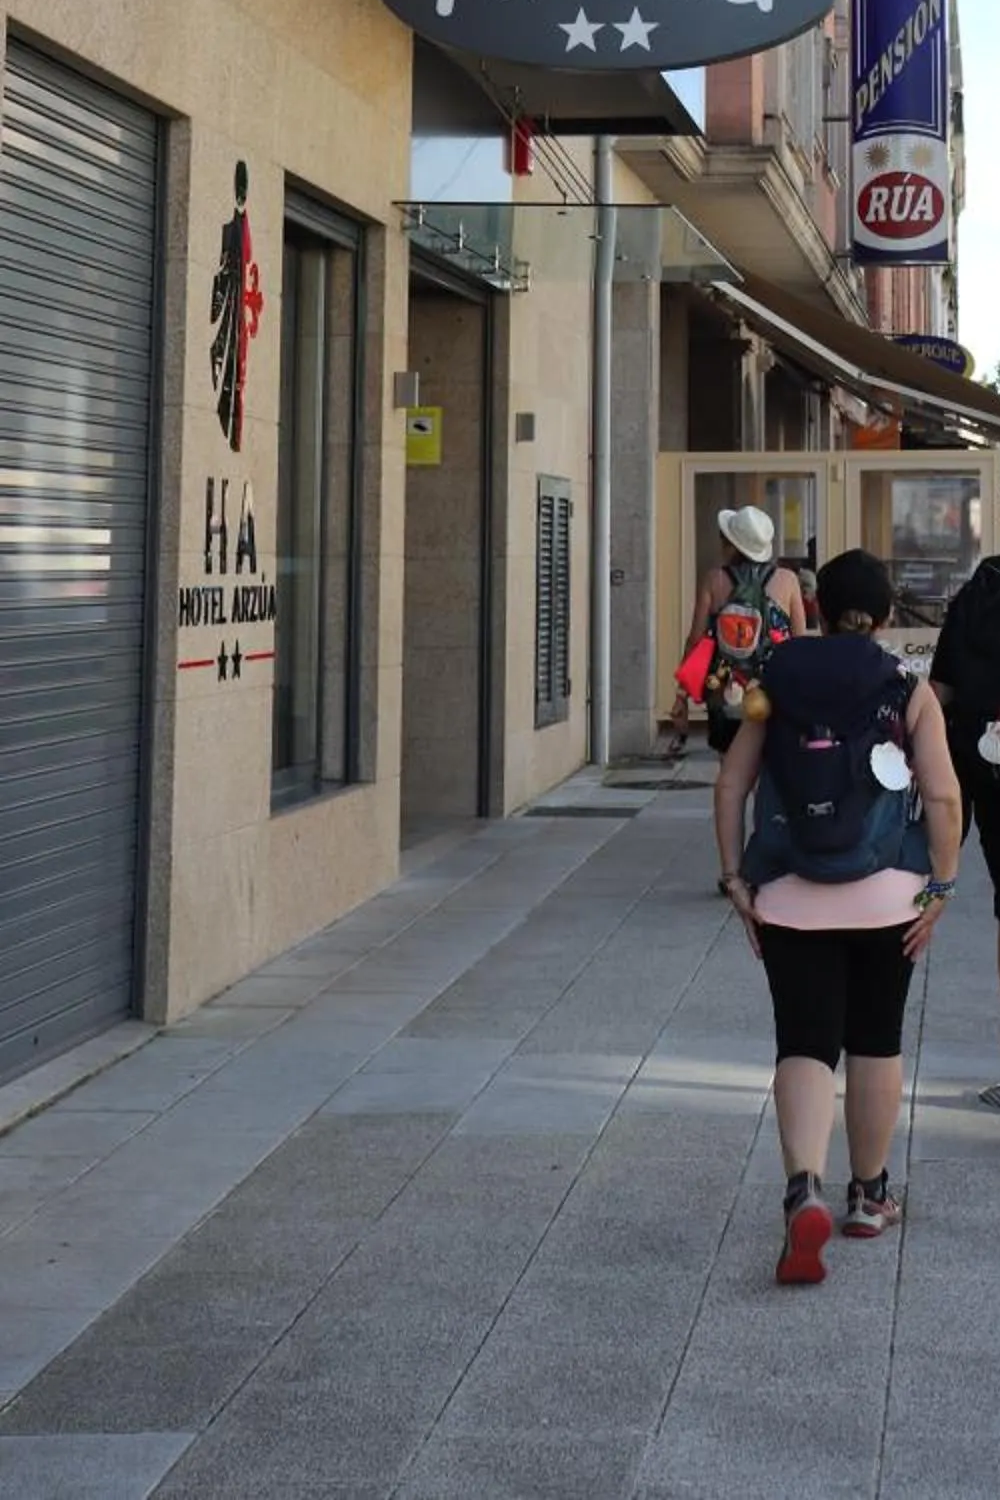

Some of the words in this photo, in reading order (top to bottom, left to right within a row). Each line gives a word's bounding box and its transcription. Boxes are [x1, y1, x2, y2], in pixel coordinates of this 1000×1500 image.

[864, 173, 936, 223] RÚA
[178, 586, 227, 627] HOTEL
[231, 571, 277, 624] ARZÚA
